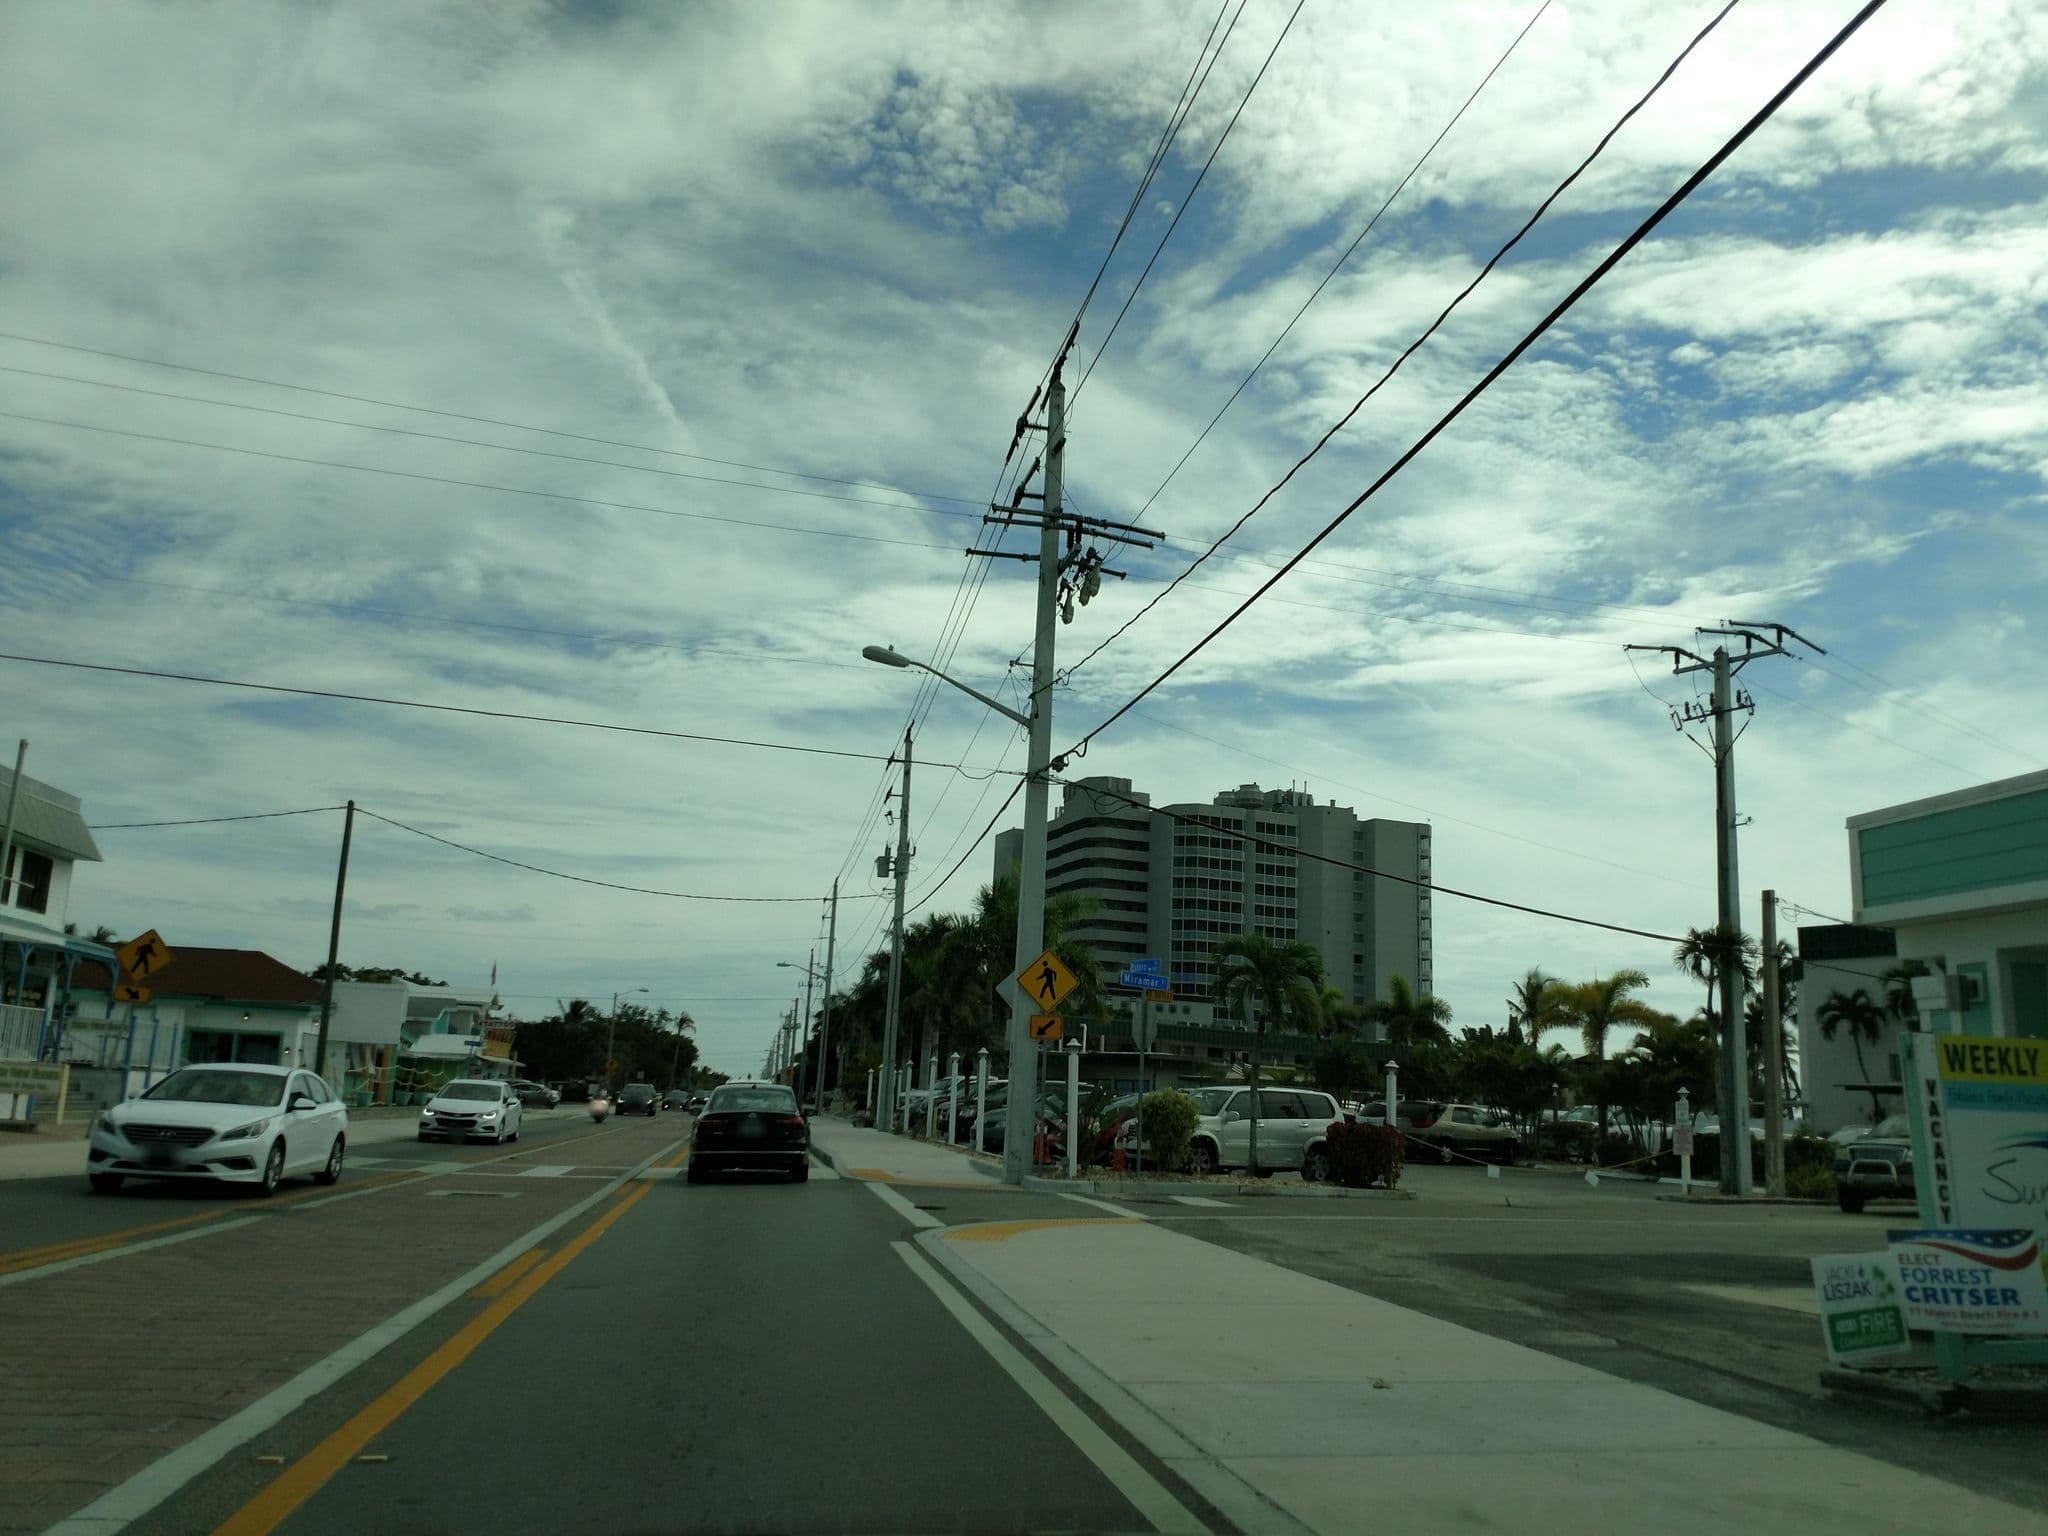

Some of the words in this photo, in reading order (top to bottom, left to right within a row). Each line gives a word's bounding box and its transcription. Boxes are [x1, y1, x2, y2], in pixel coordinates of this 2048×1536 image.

[1124, 973, 1159, 987] Miramar
[1943, 1043, 2039, 1077] WEEKLY
[1925, 1079, 1951, 1224] VACANCY
[1897, 1253, 1941, 1266] ELECT
[1900, 1267, 1993, 1285] FORREST
[1823, 1281, 1873, 1301] LISZAK
[1905, 1285, 2021, 1306] CRITSER
[1859, 1311, 1898, 1333] FIRE
